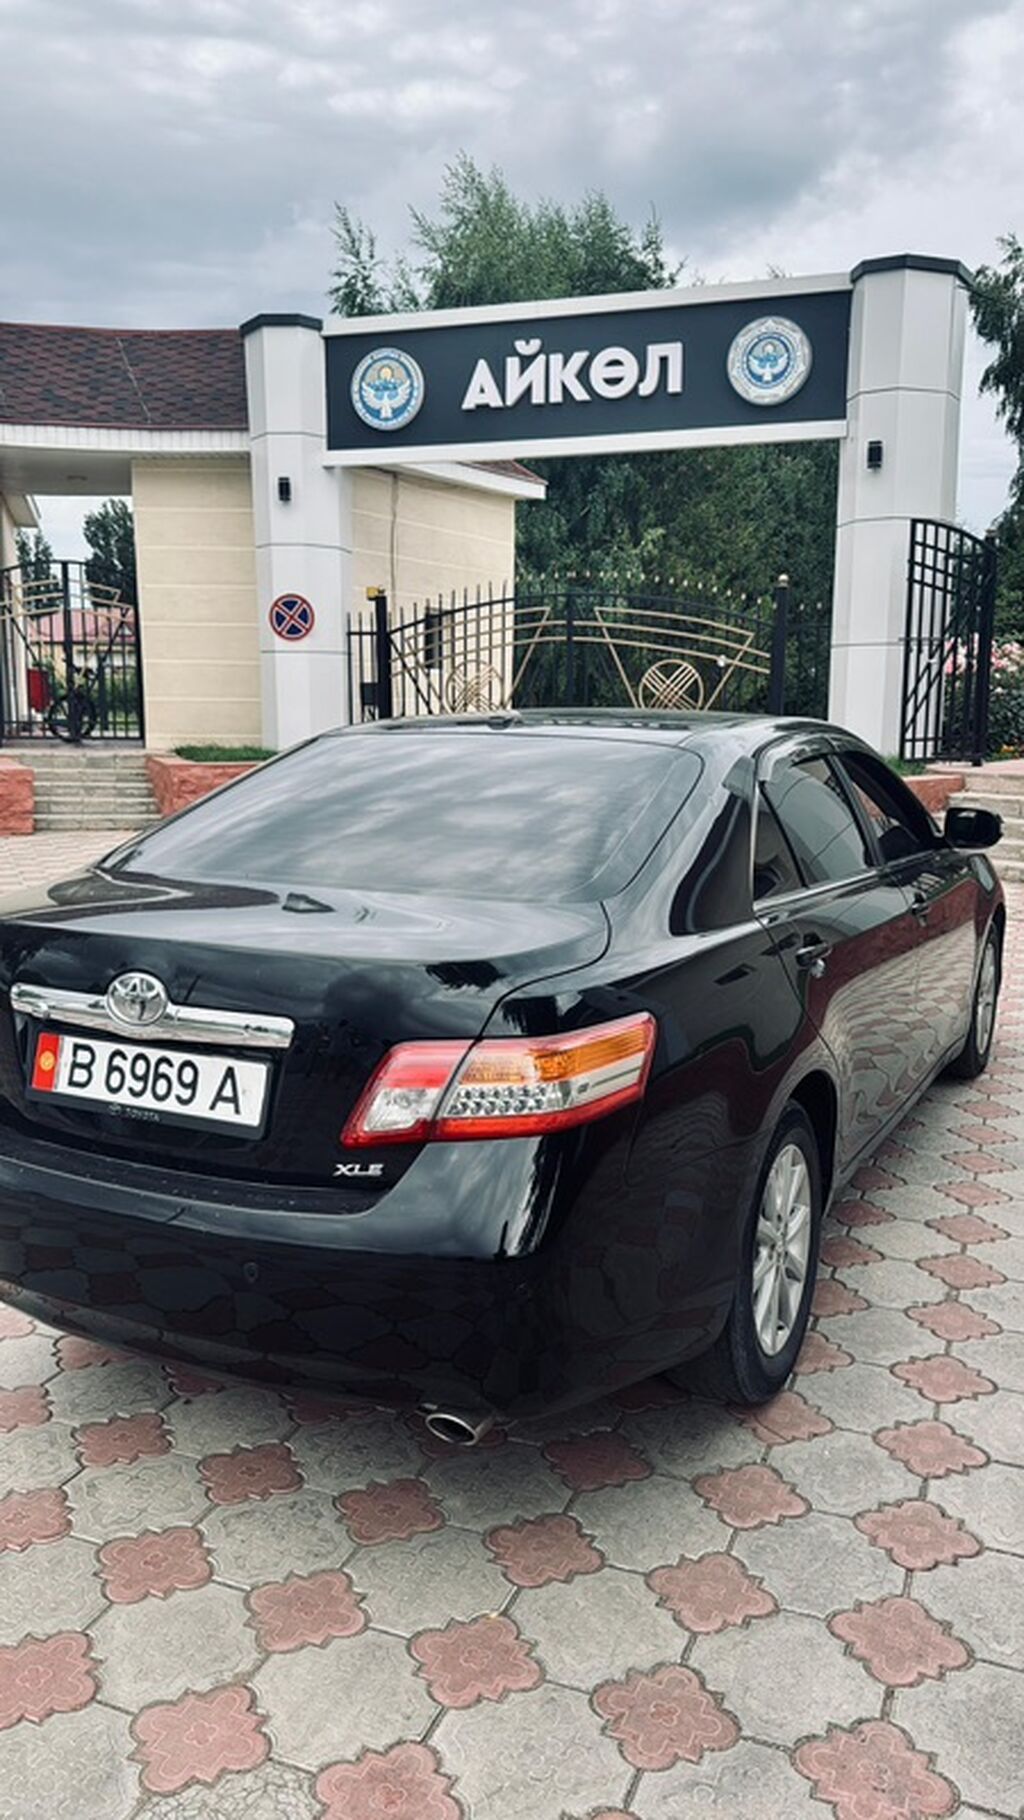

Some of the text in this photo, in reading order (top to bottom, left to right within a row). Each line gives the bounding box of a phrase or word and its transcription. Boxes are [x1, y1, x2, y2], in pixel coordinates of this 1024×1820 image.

[461, 338, 684, 410] АЙКӨЛ
[68, 1042, 242, 1115] B 6969 A
[332, 1163, 384, 1177] XLE
